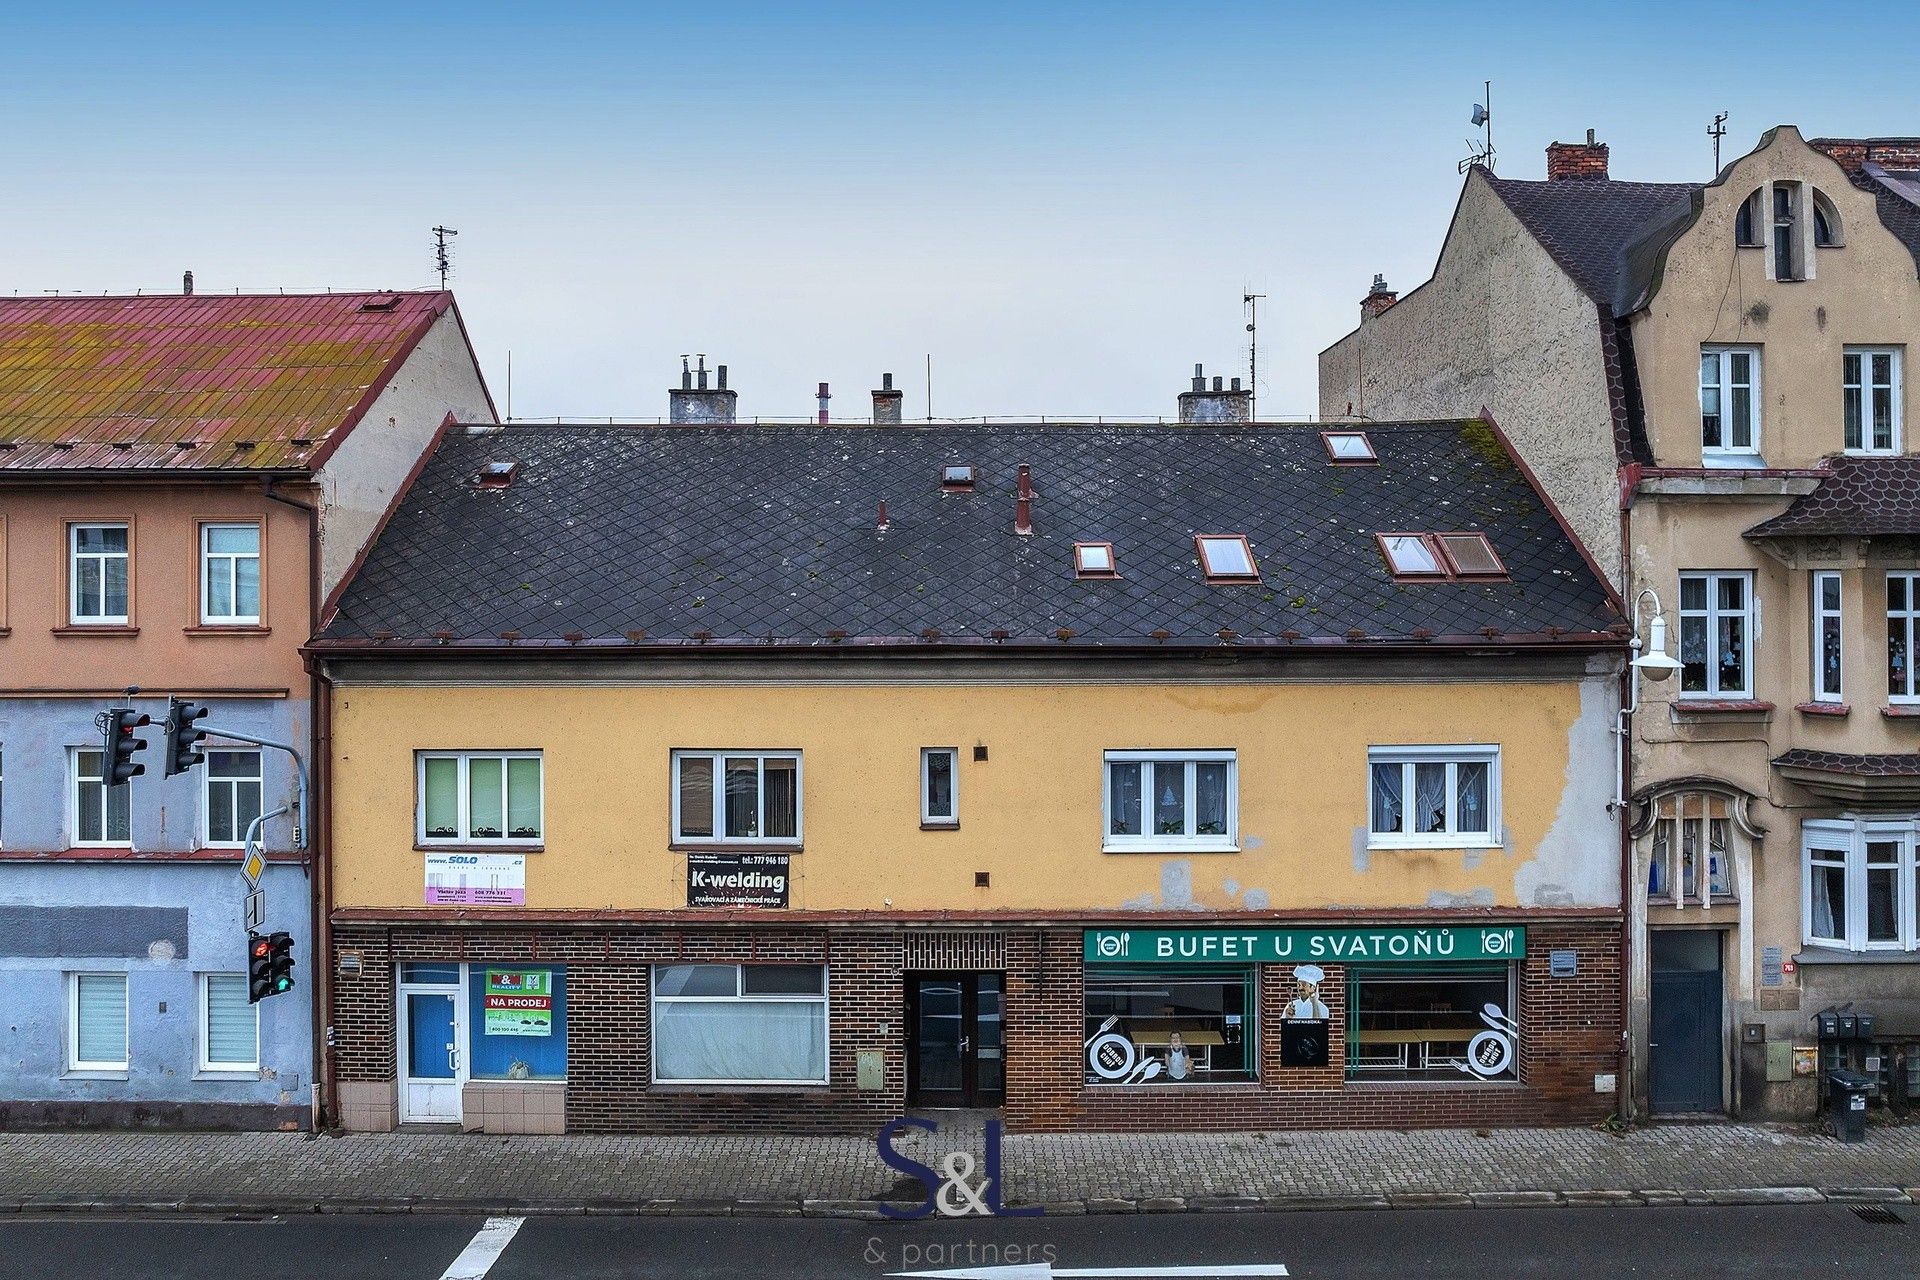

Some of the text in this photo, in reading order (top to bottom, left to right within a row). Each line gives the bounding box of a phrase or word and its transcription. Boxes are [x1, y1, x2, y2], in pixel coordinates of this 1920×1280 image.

[754, 856, 764, 864] 777
[766, 856, 776, 864] 946
[778, 857, 788, 865] 180
[691, 871, 785, 893] K-welding
[1157, 928, 1454, 957] BUFET U SVATOŇŮ
[490, 998, 547, 1008] NA PRODEJ
[1102, 1043, 1125, 1066] DOBROU
